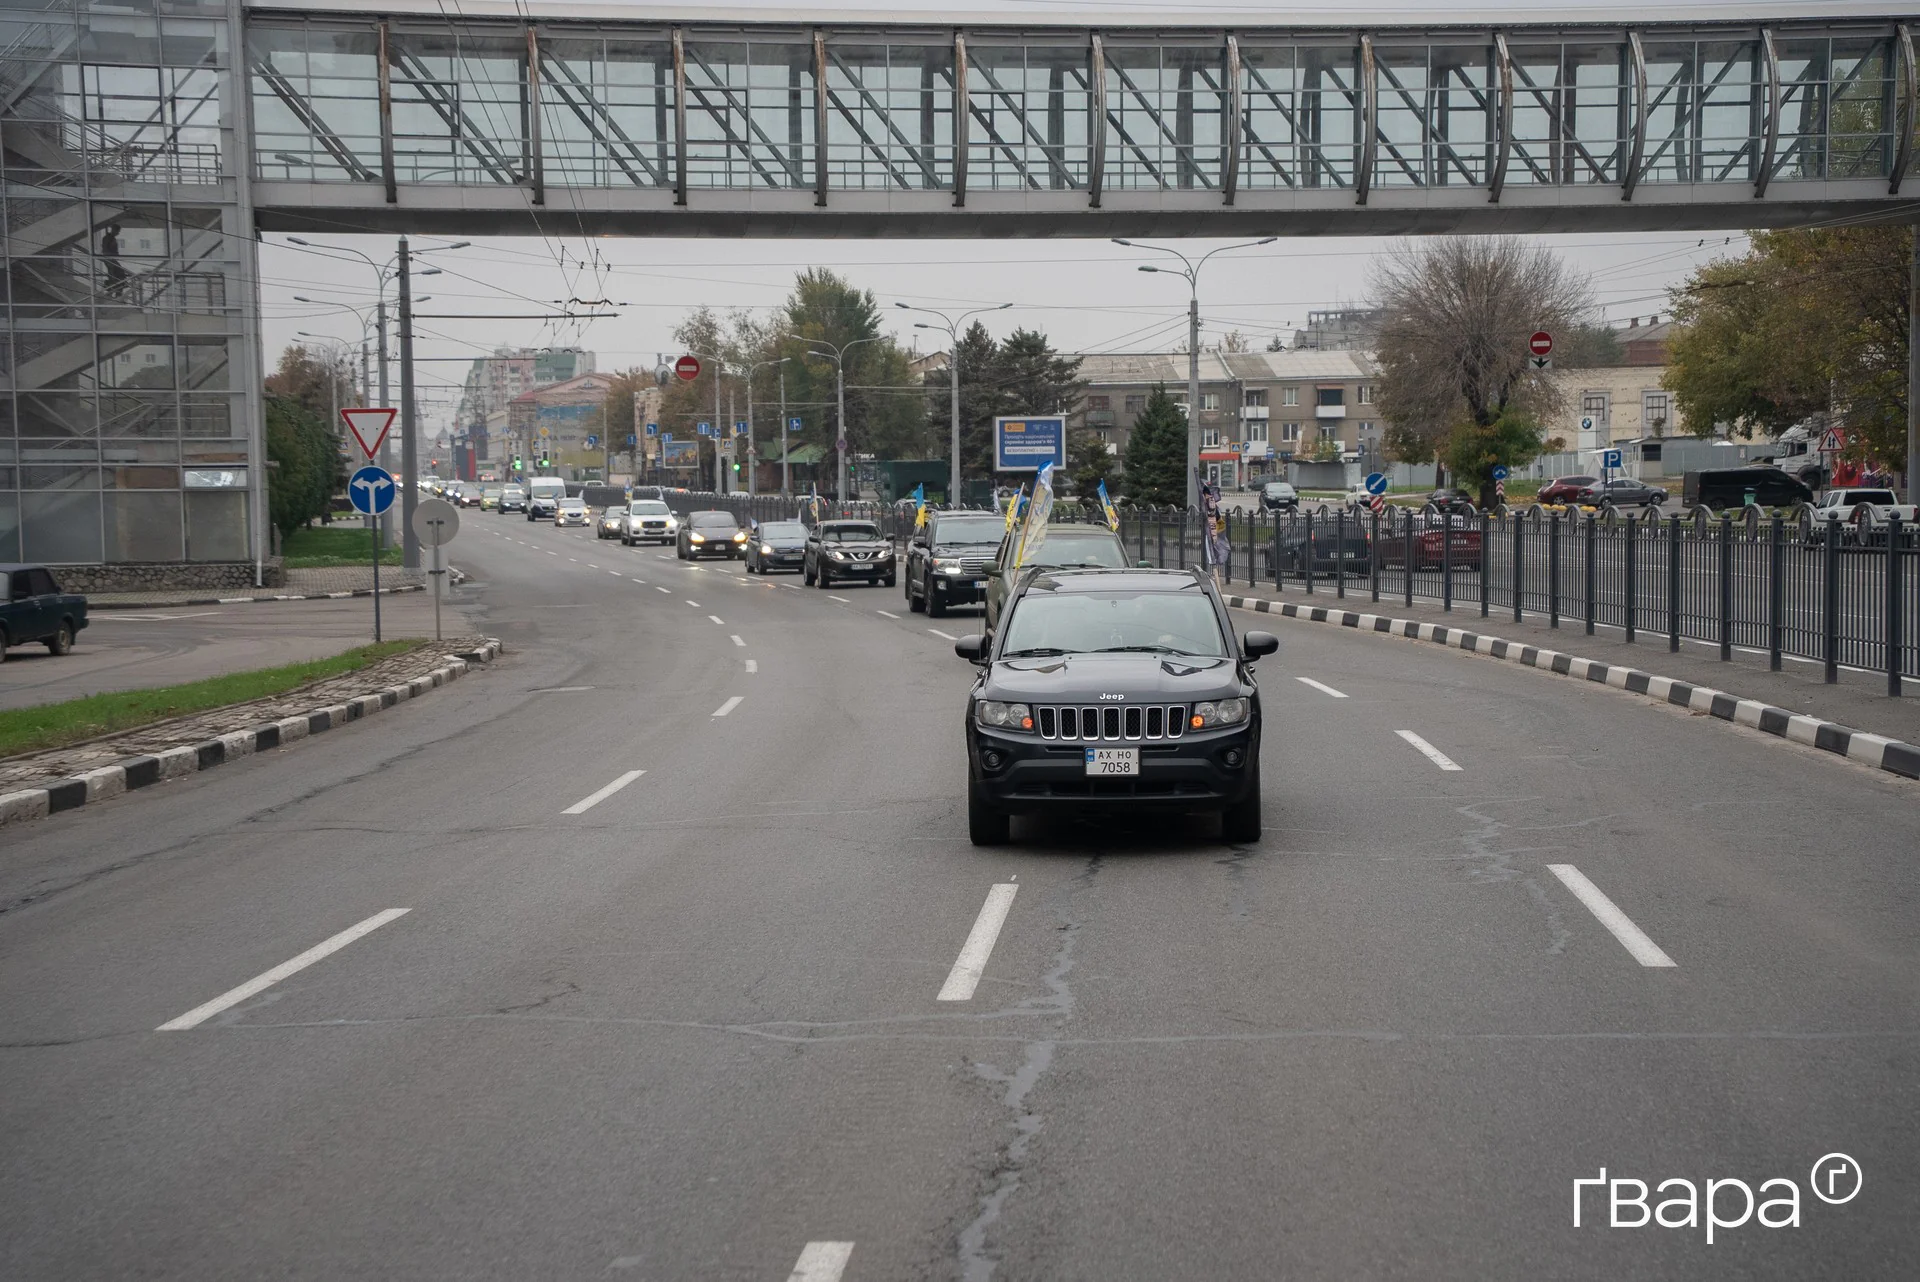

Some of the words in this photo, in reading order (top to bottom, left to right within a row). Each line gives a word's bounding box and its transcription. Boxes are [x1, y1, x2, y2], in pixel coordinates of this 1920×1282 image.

[1099, 693, 1125, 701] Jeep
[1098, 751, 1112, 759] AX
[1117, 751, 1132, 759] HO
[1100, 761, 1131, 773] 7058
